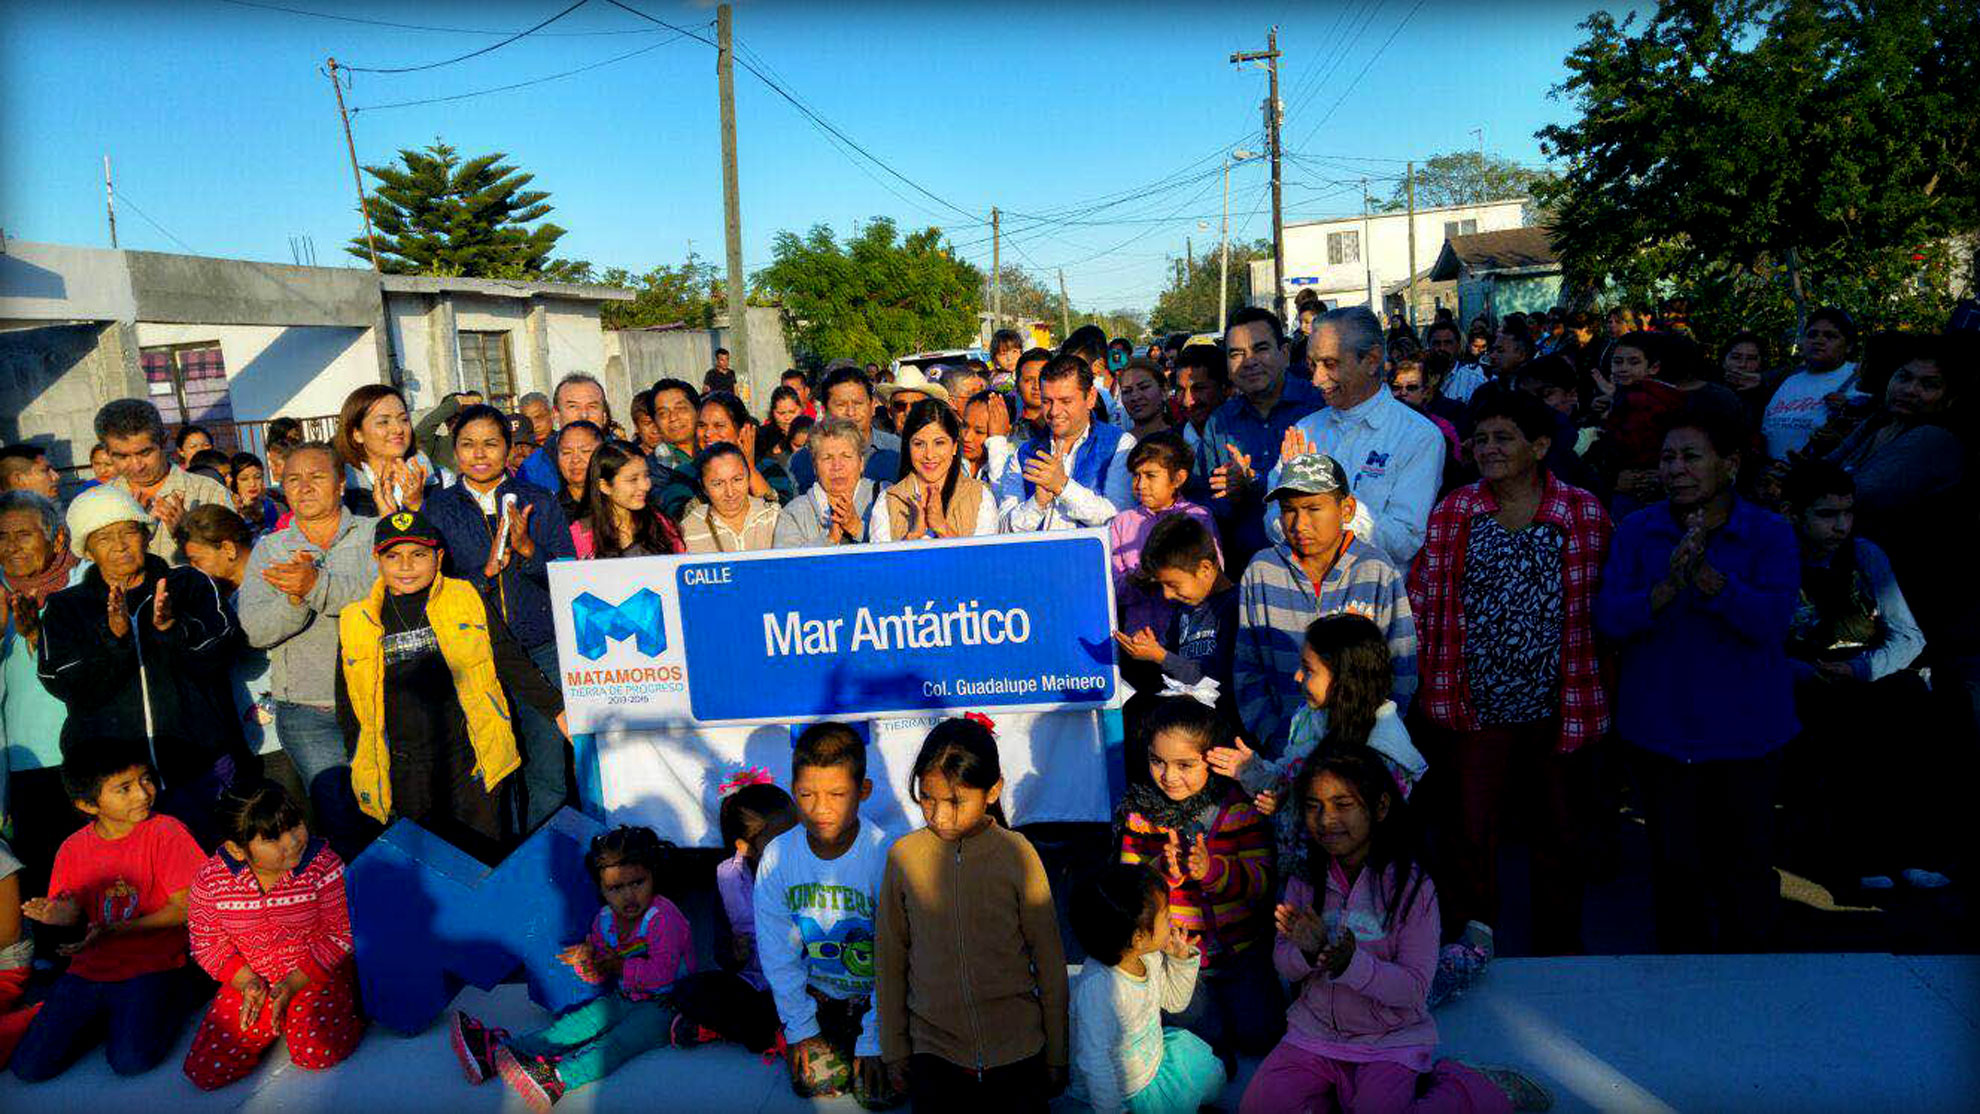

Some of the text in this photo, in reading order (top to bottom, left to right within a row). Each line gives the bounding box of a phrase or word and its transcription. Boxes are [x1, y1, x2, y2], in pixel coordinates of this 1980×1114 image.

[684, 567, 732, 586] CALLE
[763, 600, 1030, 657] Mar Antártico
[567, 666, 682, 686] MATAMOROS
[571, 682, 684, 697] TIERRA DE PROGRESO
[923, 675, 1105, 697] Col. Guadalupe Mainero
[883, 717, 927, 731] TIERRA
